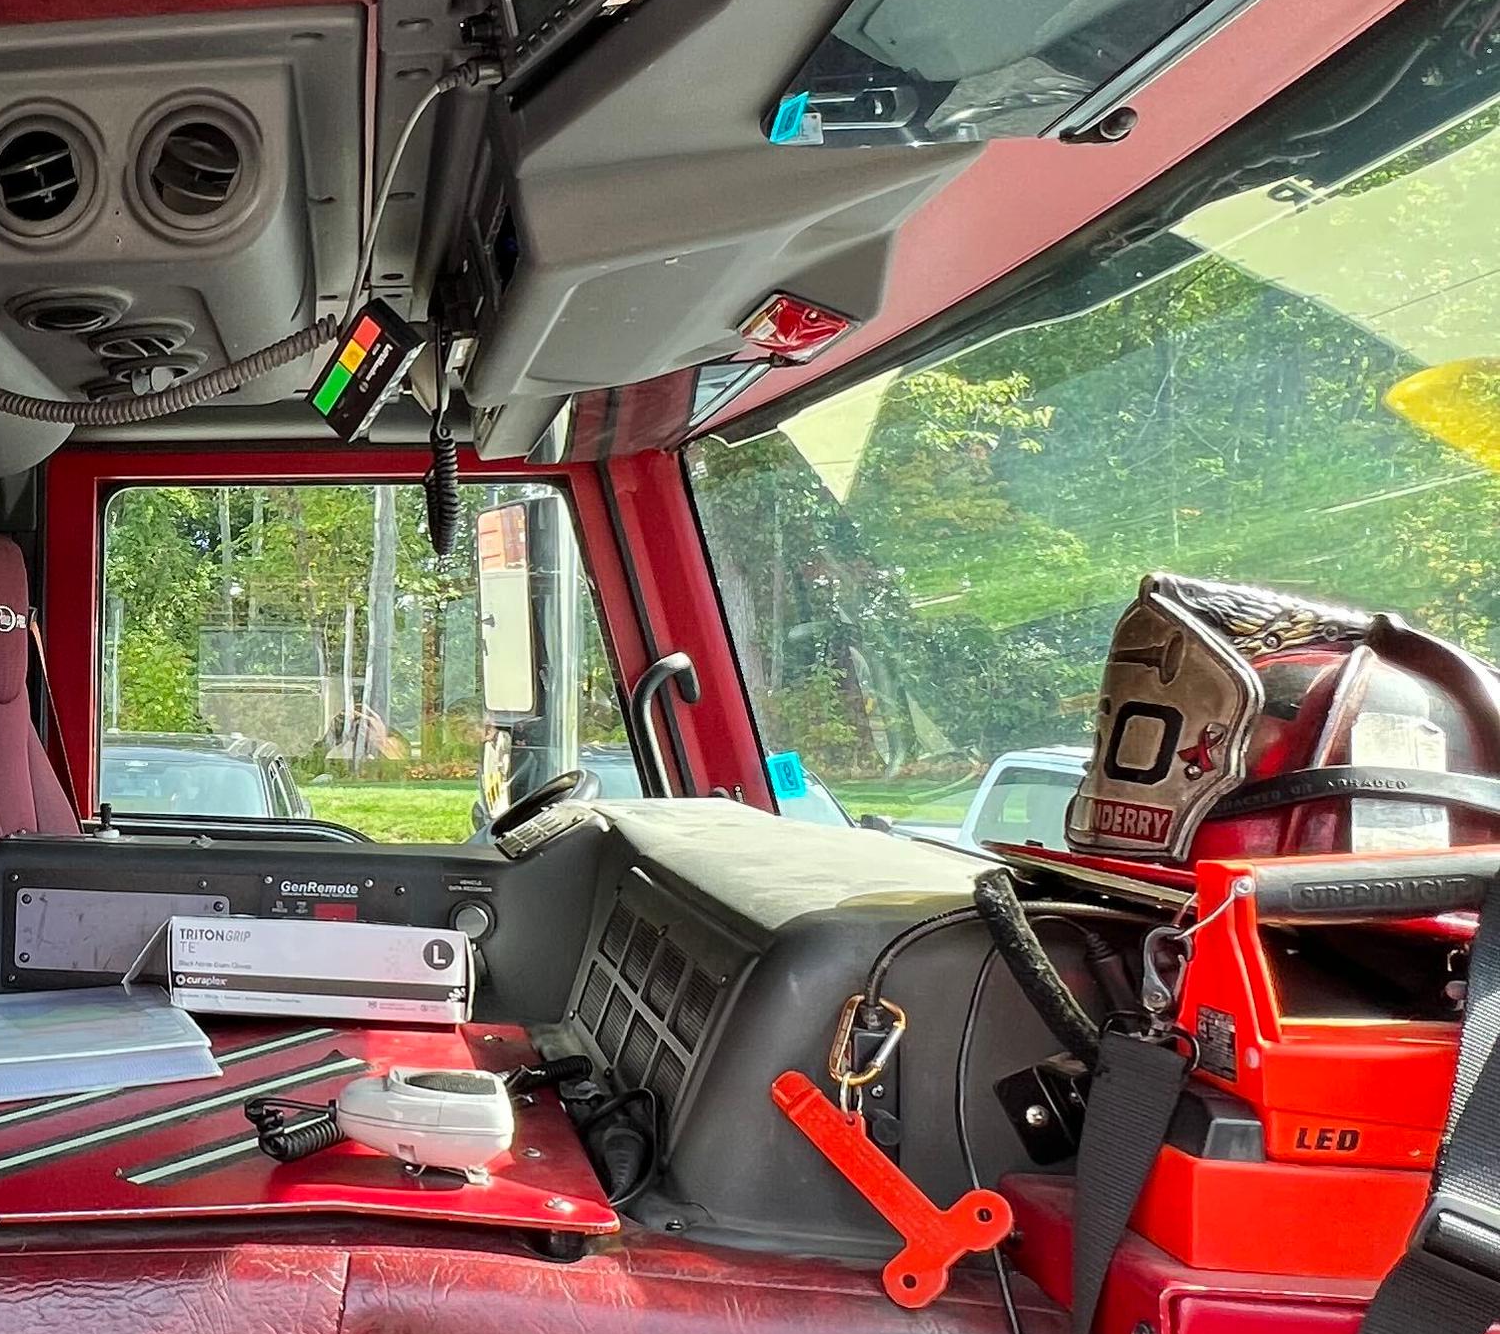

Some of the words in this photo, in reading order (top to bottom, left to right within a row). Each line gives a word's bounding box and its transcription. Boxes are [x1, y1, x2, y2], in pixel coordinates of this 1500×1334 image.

[280, 880, 359, 894] GenRemote
[432, 945, 447, 964] L
[1295, 1127, 1361, 1152] LED
